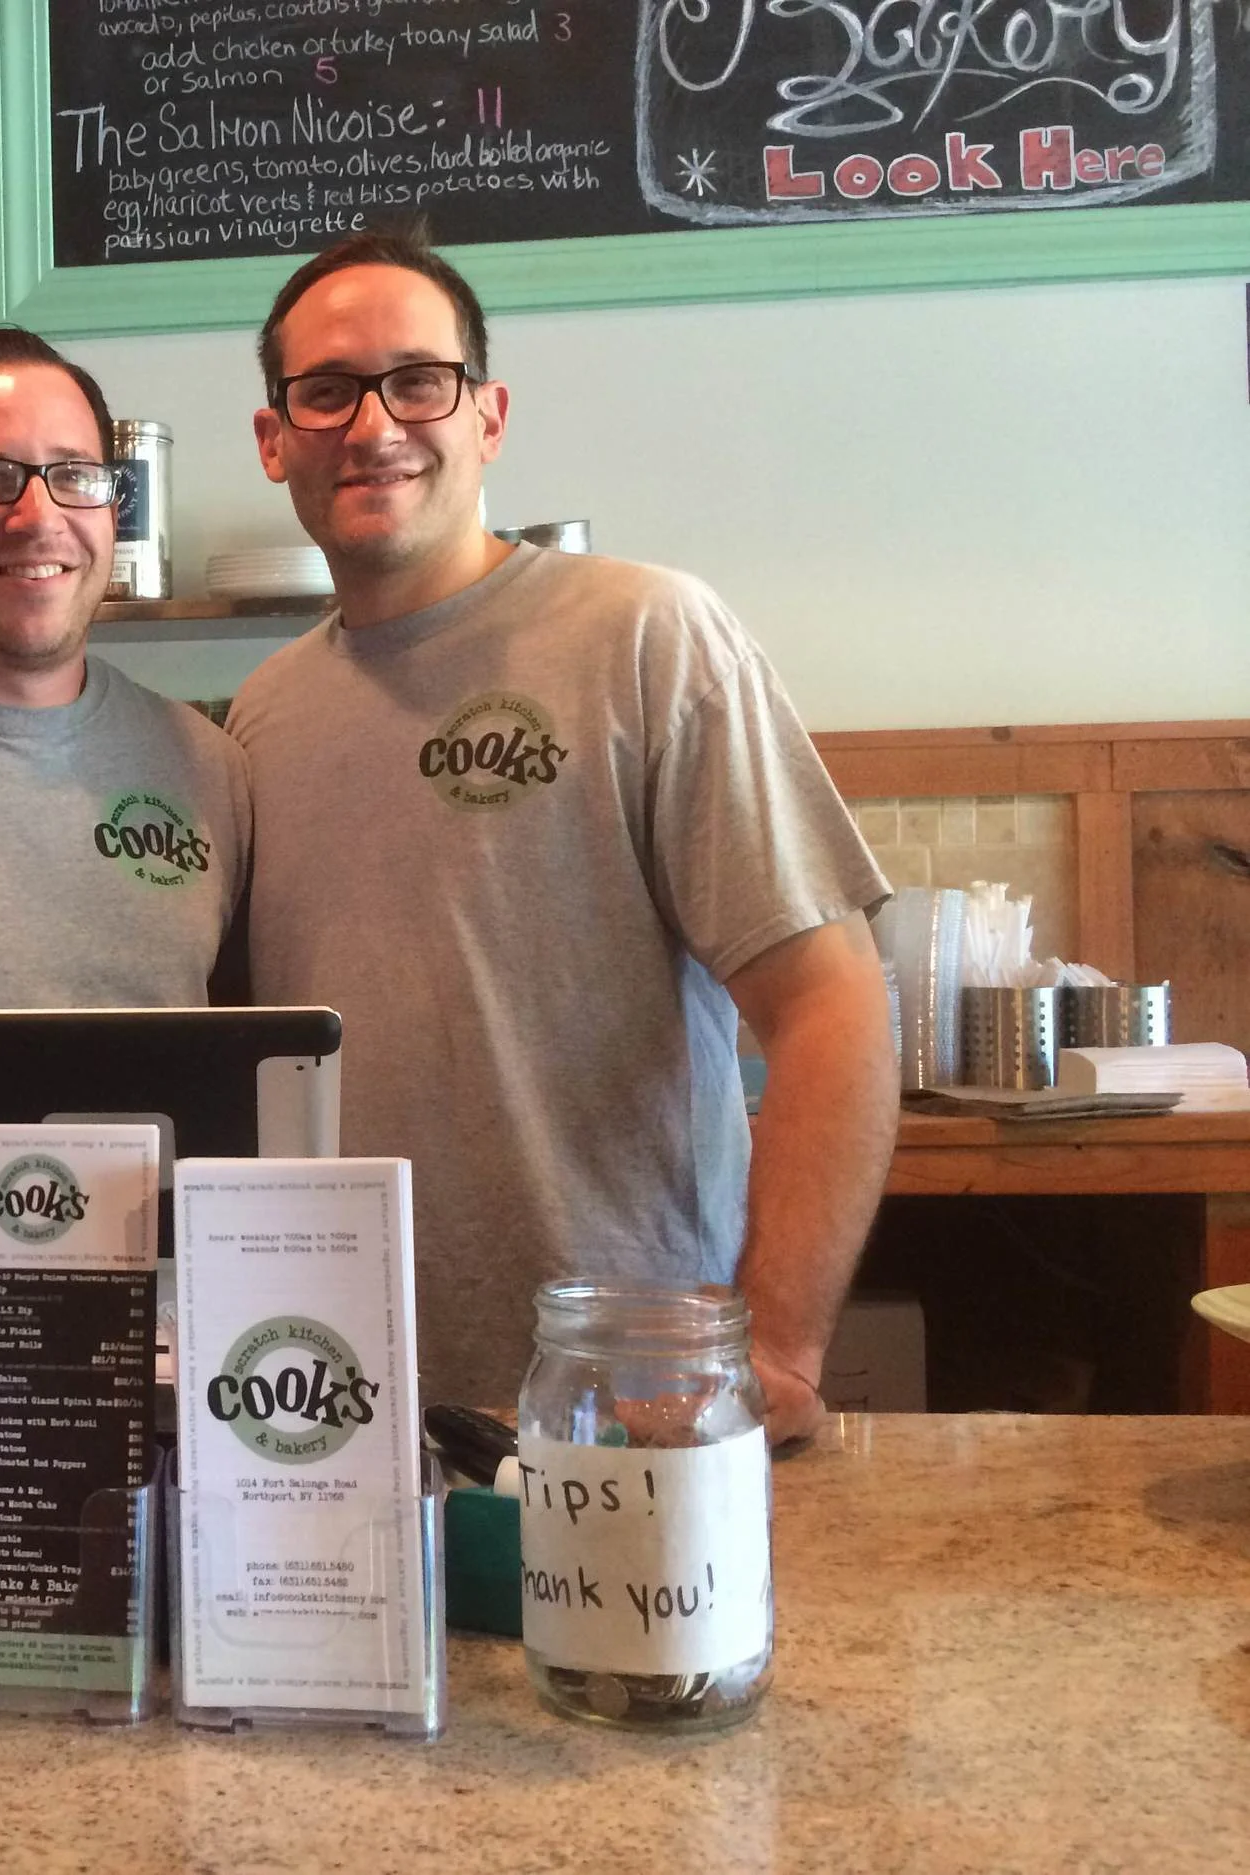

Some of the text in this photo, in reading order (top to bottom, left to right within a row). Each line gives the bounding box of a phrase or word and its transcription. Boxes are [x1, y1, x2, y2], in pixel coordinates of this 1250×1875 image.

[141, 9, 539, 70] add chicken or turkey to any salad
[554, 12, 572, 41] 3
[144, 77, 168, 95] or
[315, 56, 338, 84] 5
[56, 101, 147, 173] The
[108, 129, 610, 201] baby greens, tomato, olives, hard boiled organic
[1020, 125, 1166, 191] Here
[103, 199, 148, 232] egg,
[152, 188, 234, 218] haricot
[240, 189, 301, 214] verts
[324, 184, 353, 206] red
[360, 183, 412, 204] bliss
[540, 165, 600, 190] with
[219, 211, 366, 248] vinaigrette
[500, 697, 541, 732] kitchen
[464, 790, 510, 805] bakery
[234, 1324, 342, 1375] scratch kitchen
[255, 1432, 327, 1455] & bakery
[30, 1579, 40, 1590] &
[47, 1580, 79, 1593] Bake
[522, 1560, 714, 1635] hank you!
